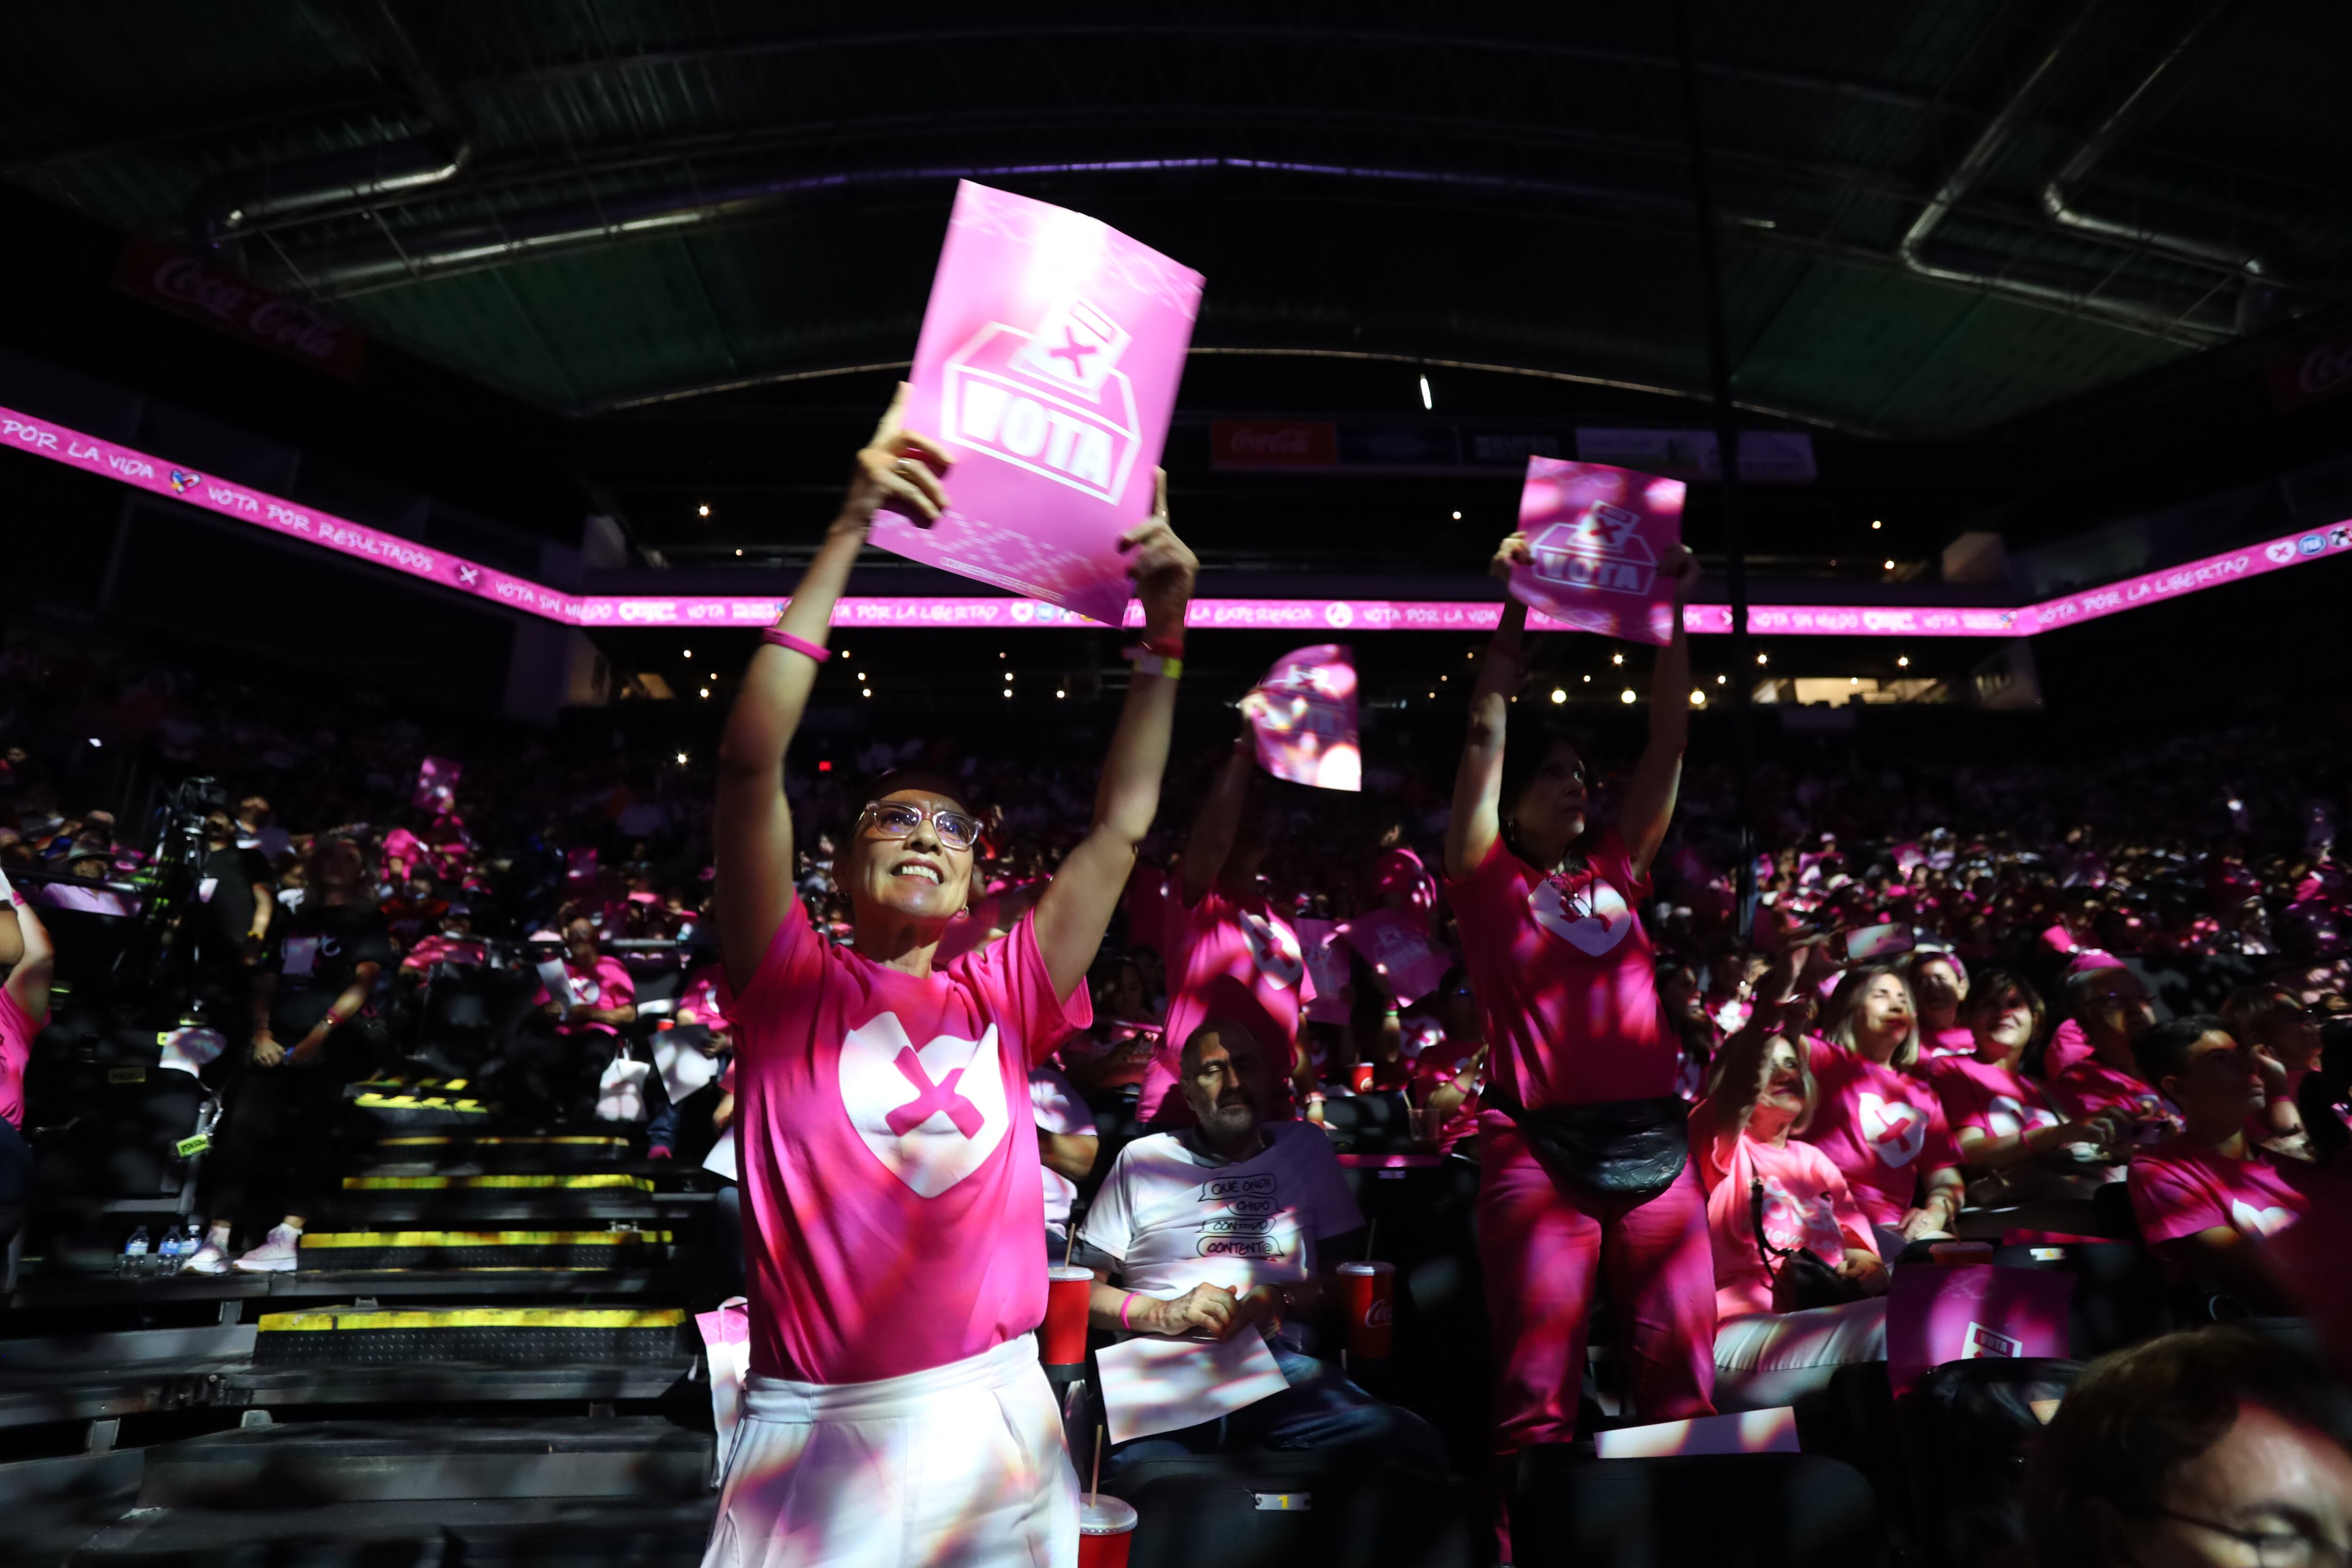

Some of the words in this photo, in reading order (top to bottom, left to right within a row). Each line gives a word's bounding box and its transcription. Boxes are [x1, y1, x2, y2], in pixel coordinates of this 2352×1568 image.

[962, 380, 1115, 485] VOTA
[2, 418, 57, 451] POR
[67, 441, 99, 462] LA
[109, 454, 154, 479] VIDA
[207, 485, 259, 514] VOTA
[267, 504, 310, 532] POR
[318, 521, 433, 572] RESULTADOS
[1542, 552, 1639, 589] VOTA
[2037, 604, 2076, 625] VOTA
[2083, 591, 2123, 611] POR
[2127, 582, 2151, 601] LA
[2155, 555, 2249, 593] LIBERTAD
[495, 581, 534, 603] VOTA
[539, 594, 560, 613] SIN
[565, 603, 612, 621] MIEDO
[687, 604, 725, 619] VOTA
[856, 605, 890, 620] POR
[896, 605, 918, 619] LA
[920, 605, 998, 621] LIBERTAD
[1190, 608, 1210, 621] LA
[1215, 607, 1312, 622] EXPERIENCIA
[1363, 608, 1401, 622] VOTA
[1406, 608, 1438, 622] POR
[1445, 609, 1463, 622] LA
[1469, 609, 1499, 622] VIDA
[1754, 612, 1788, 627] VOTA
[1792, 613, 1813, 627] SIN
[1816, 613, 1858, 629] MIEDO
[1924, 613, 1959, 629] VOTA
[1236, 1201, 1270, 1210] CHIDO
[1207, 1242, 1272, 1255] CONTENT@
[1980, 1332, 2007, 1353] VOTA
[1278, 1495, 1288, 1509] 1
